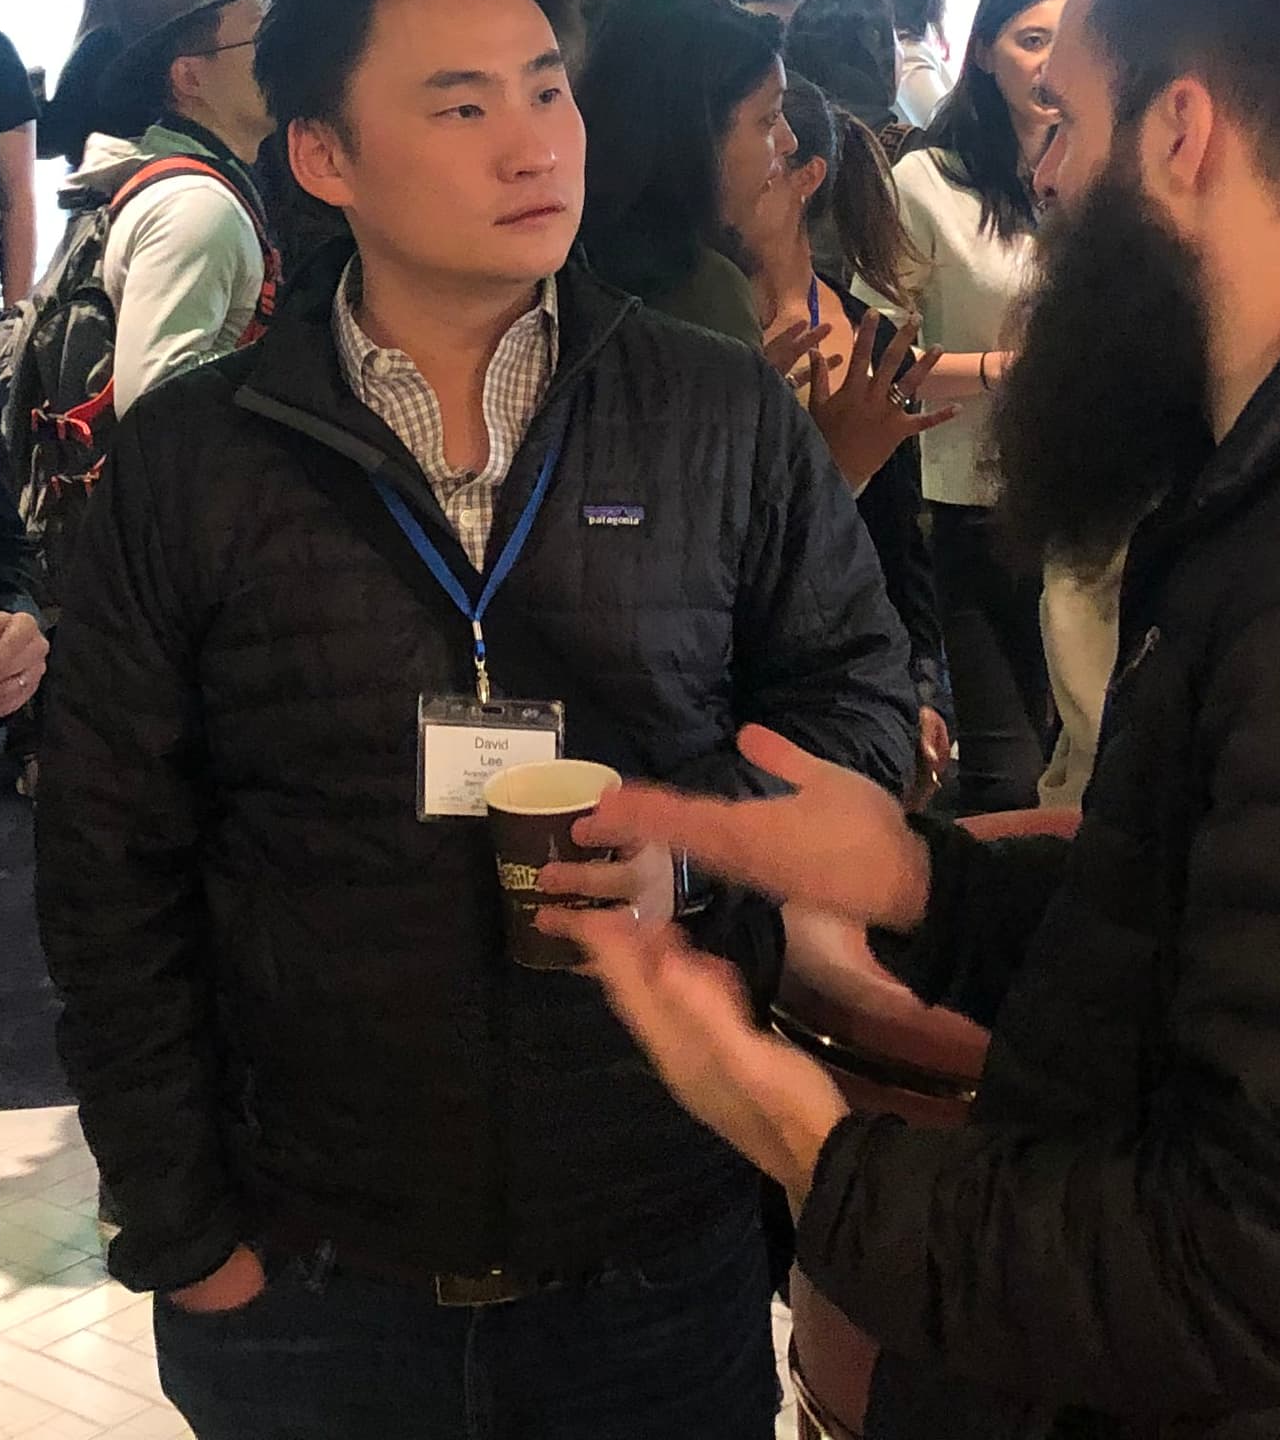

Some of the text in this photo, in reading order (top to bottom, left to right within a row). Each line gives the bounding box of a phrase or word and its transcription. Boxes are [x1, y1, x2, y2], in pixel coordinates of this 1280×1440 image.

[588, 516, 640, 526] patagonia
[474, 736, 509, 750] David
[480, 755, 503, 766] Lee
